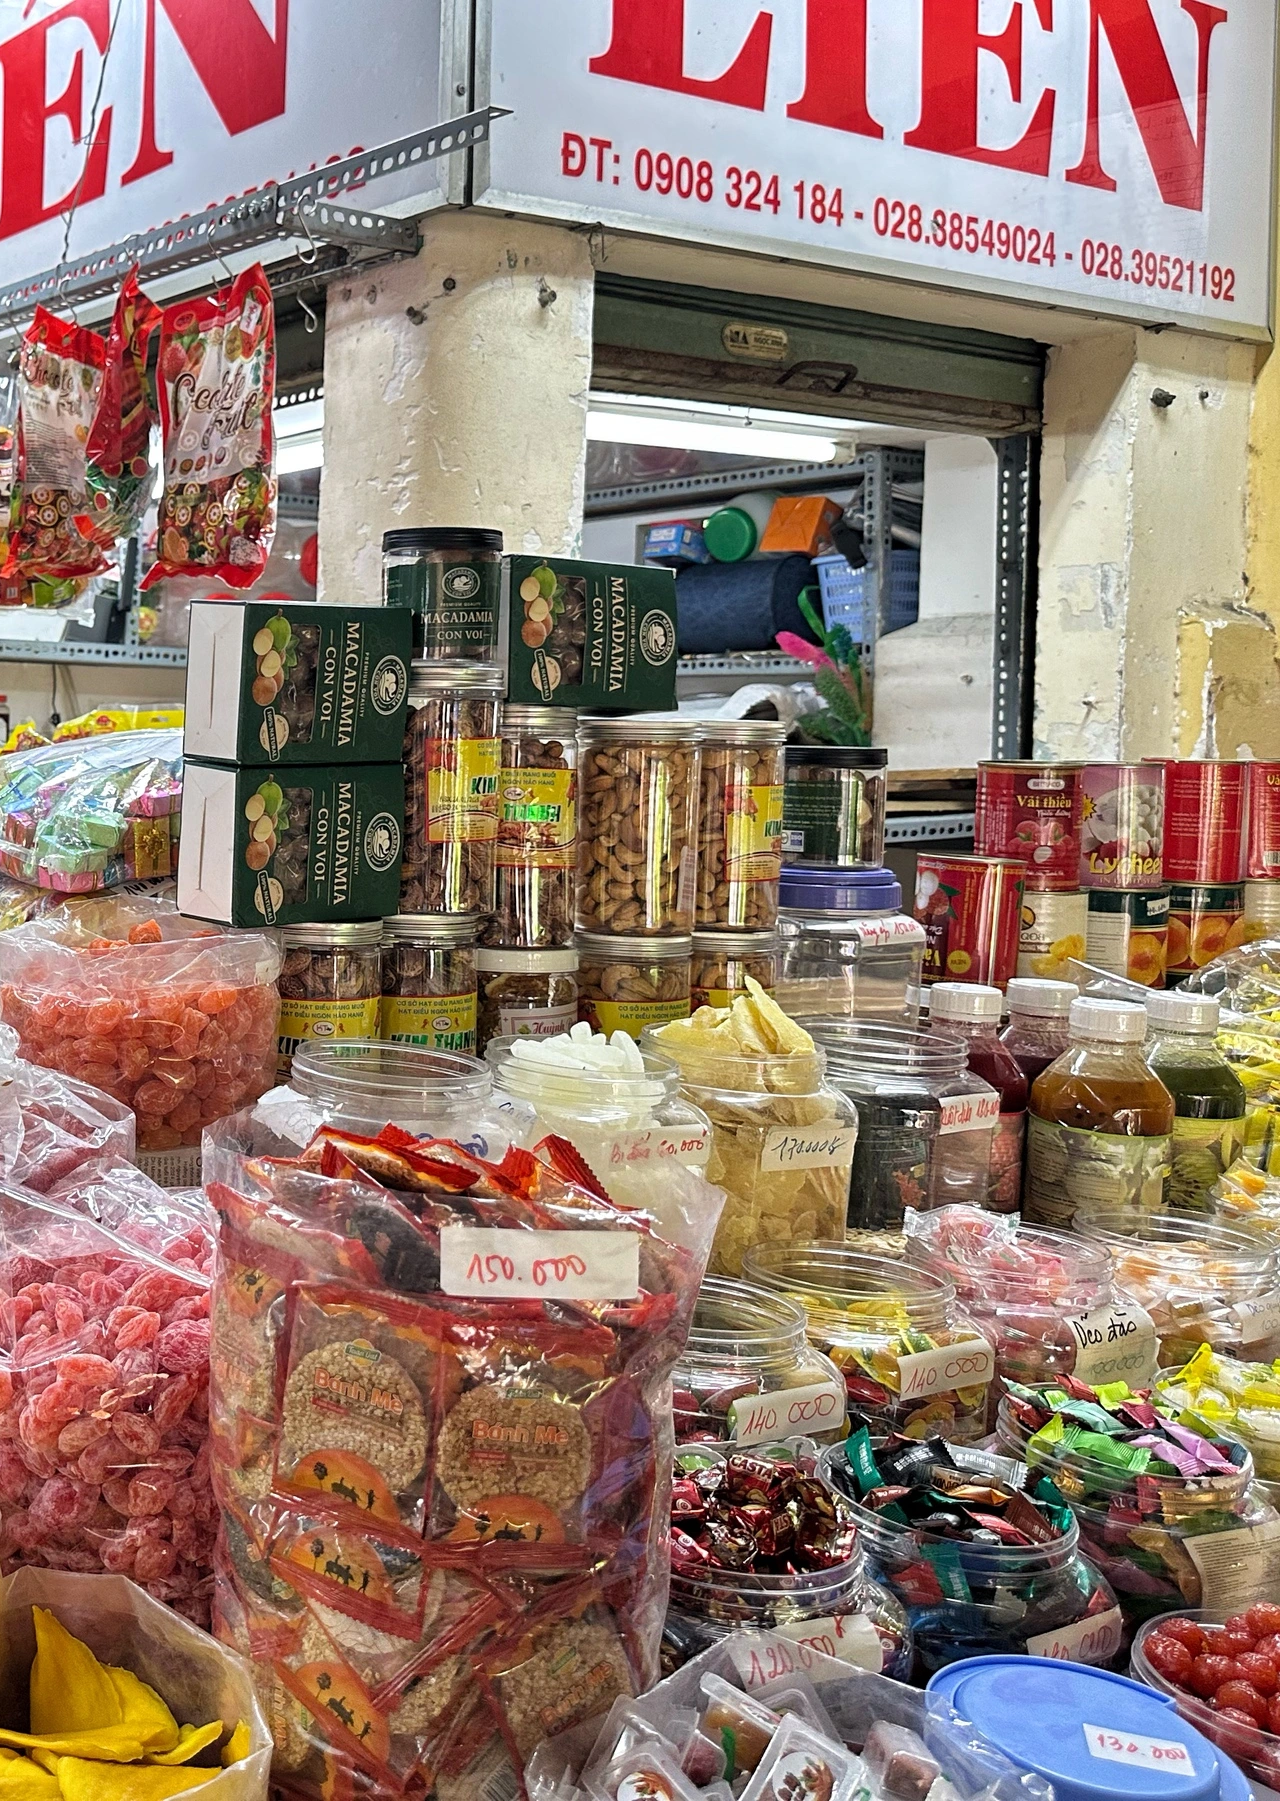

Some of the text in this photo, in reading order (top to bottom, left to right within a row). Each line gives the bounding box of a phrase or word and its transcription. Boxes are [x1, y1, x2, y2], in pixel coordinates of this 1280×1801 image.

[560, 131, 621, 187] ĐT:
[633, 147, 714, 201] 0908
[725, 164, 782, 216] 324
[792, 178, 845, 228] 184
[1080, 238, 1237, 303] 028.39521192
[420, 611, 494, 624] MACADAMIA
[437, 630, 483, 640] CON VOI
[590, 597, 603, 667] CON VOI
[609, 577, 624, 692] MACADAMIA
[320, 647, 336, 721] CON VOI
[337, 622, 360, 746] MACADAMIA
[314, 808, 328, 881] CON VOI
[334, 783, 352, 905] MACADAMIA
[466, 1253, 587, 1290] 150.000
[315, 1368, 367, 1402] Bánh
[370, 1386, 404, 1415] Mè
[472, 1419, 569, 1446] Bánh Mè
